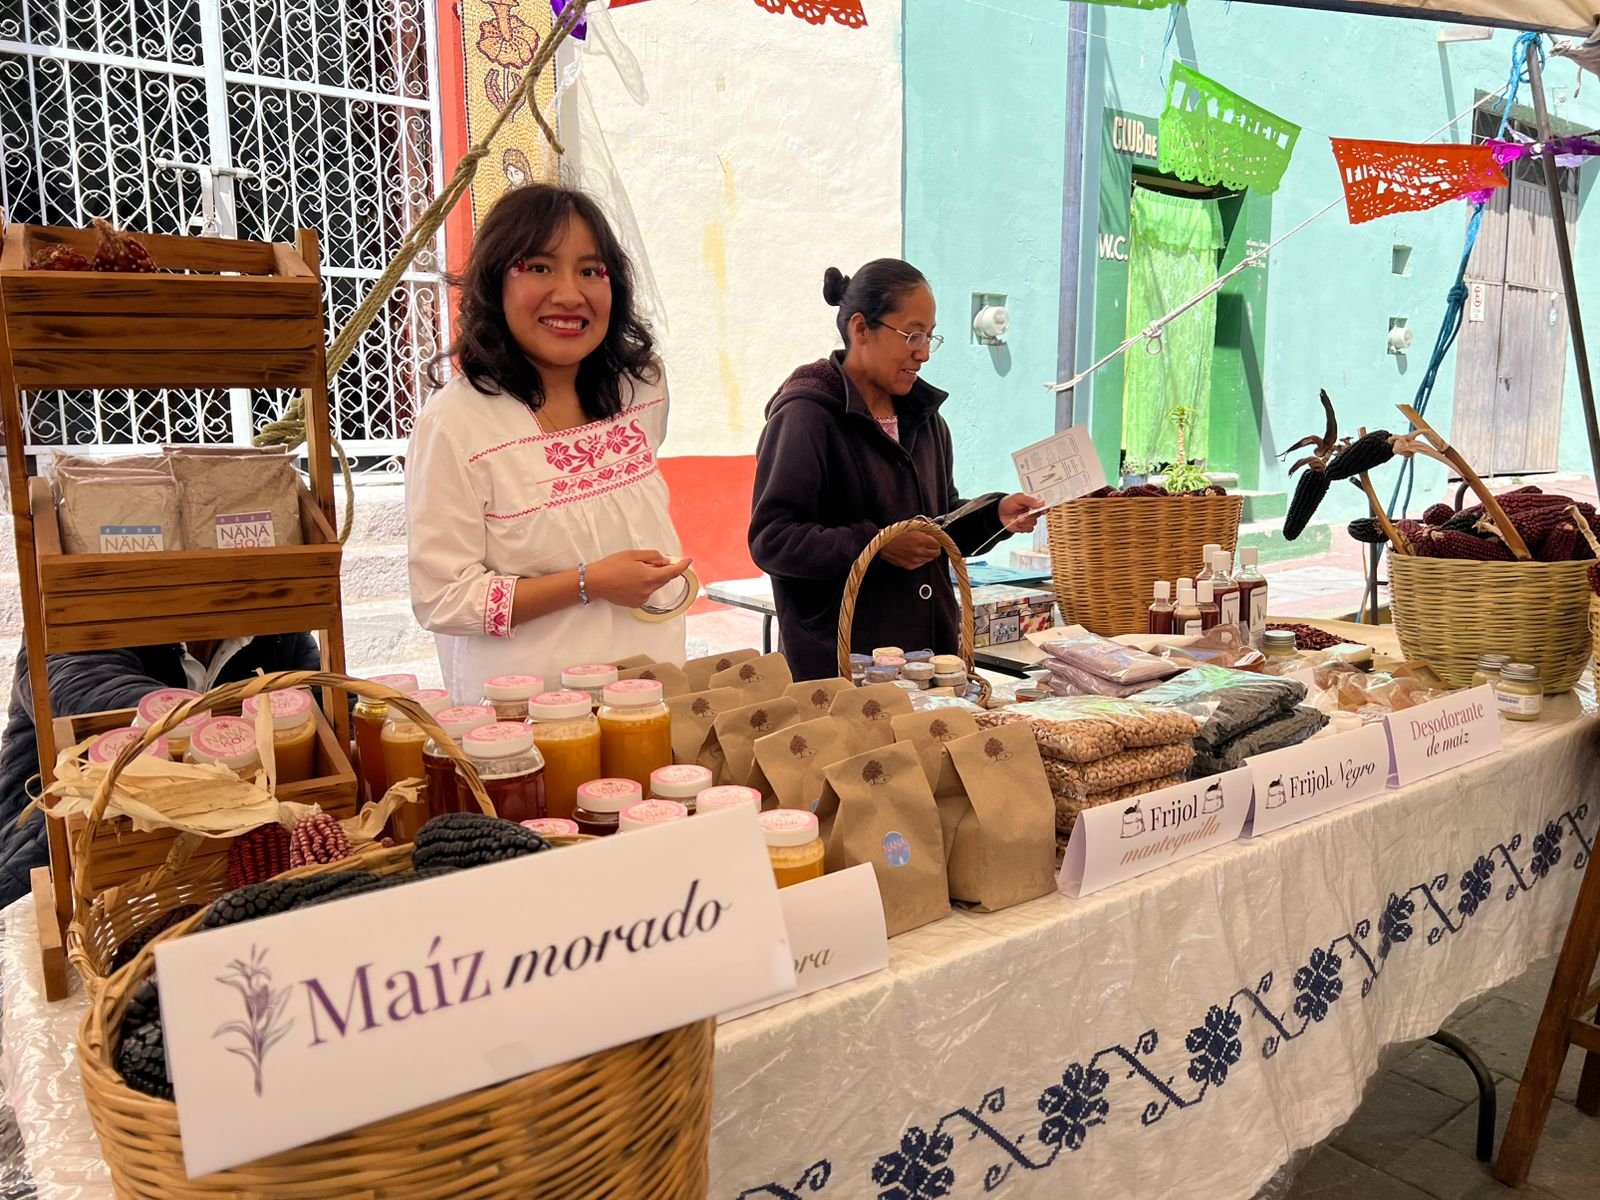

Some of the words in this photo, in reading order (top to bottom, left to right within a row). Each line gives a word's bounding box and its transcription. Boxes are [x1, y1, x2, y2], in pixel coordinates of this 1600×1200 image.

[1113, 116, 1146, 155] CLUB
[1144, 133, 1157, 157] DE
[1098, 233, 1128, 262] W.C.
[1410, 701, 1485, 741] Desodorante
[1426, 735, 1441, 758] de
[1289, 765, 1331, 799] Frijol
[1329, 758, 1376, 789] Negro
[1150, 795, 1199, 831] Frijol
[1119, 814, 1222, 867] mantequilla
[301, 936, 492, 1048] Maíz
[502, 879, 732, 990] morado
